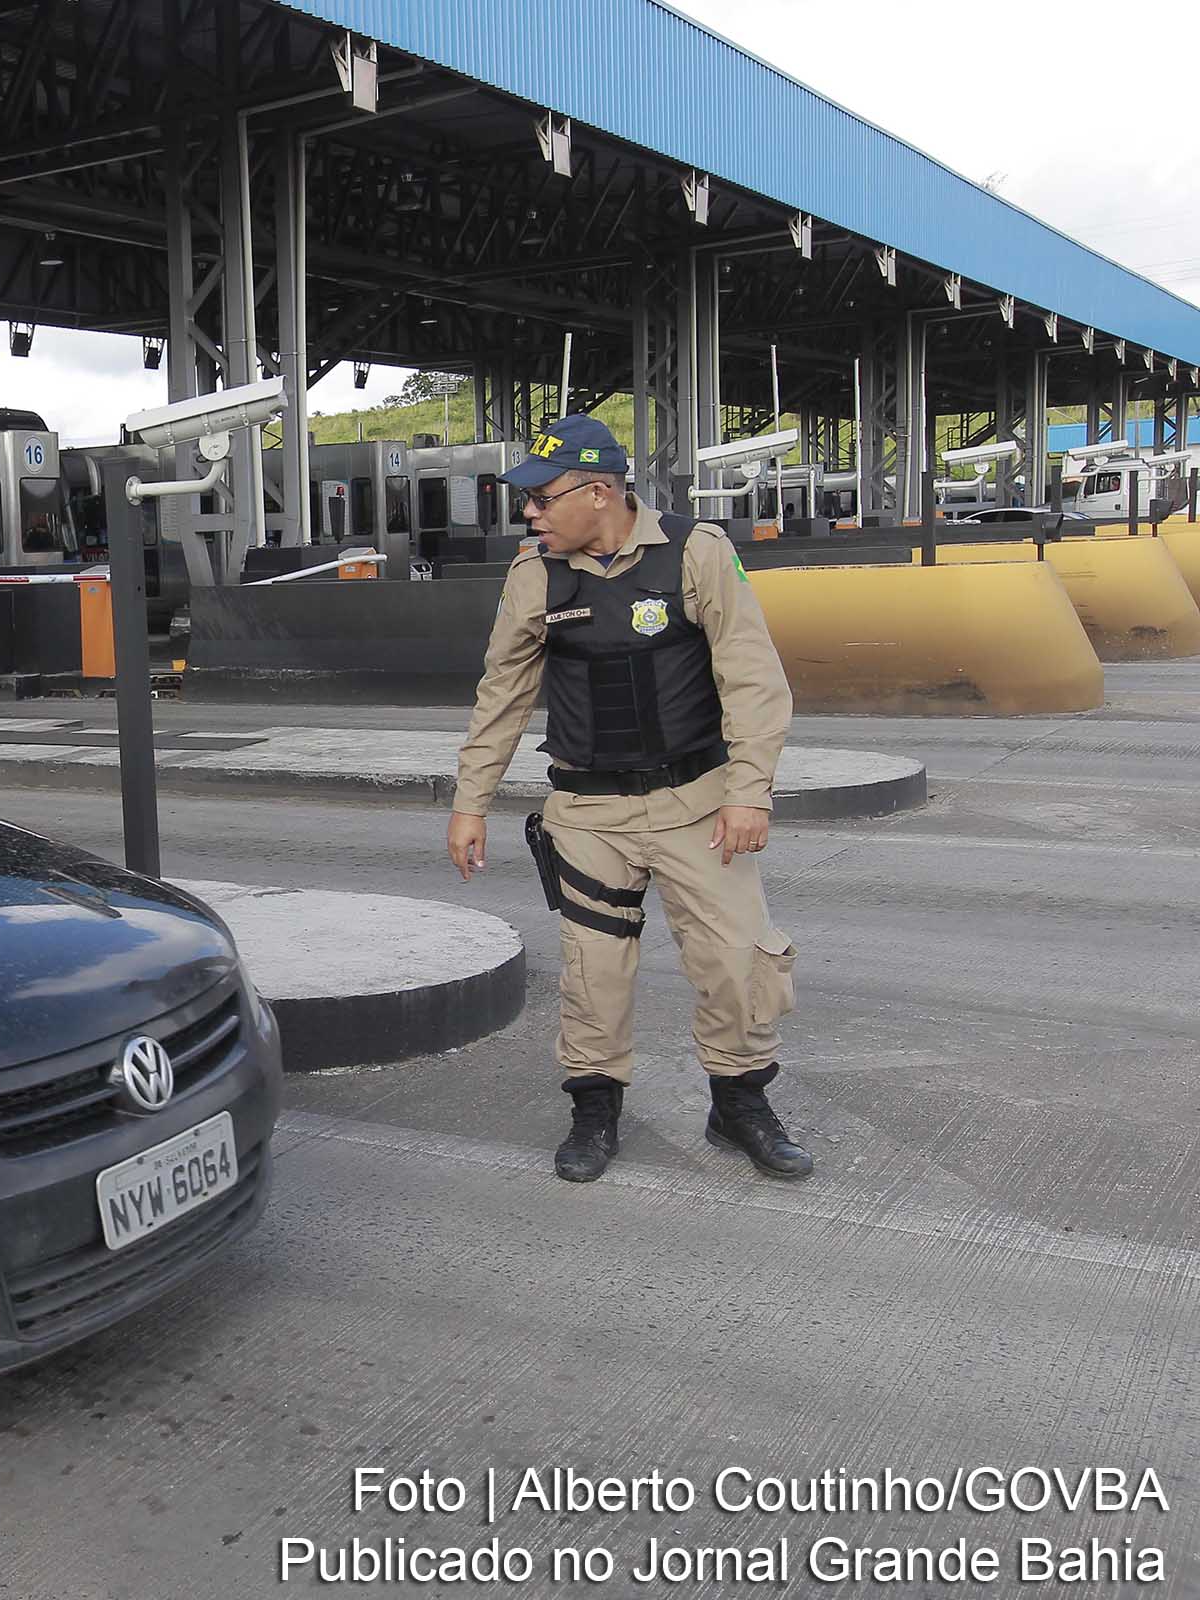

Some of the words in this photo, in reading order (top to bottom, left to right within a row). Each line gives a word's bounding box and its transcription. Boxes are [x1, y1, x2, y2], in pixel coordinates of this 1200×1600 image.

[26, 445, 42, 464] 16
[390, 452, 400, 467] 14
[512, 450, 521, 464] 13
[109, 1176, 164, 1237] NYW
[172, 1141, 231, 1205] 6064
